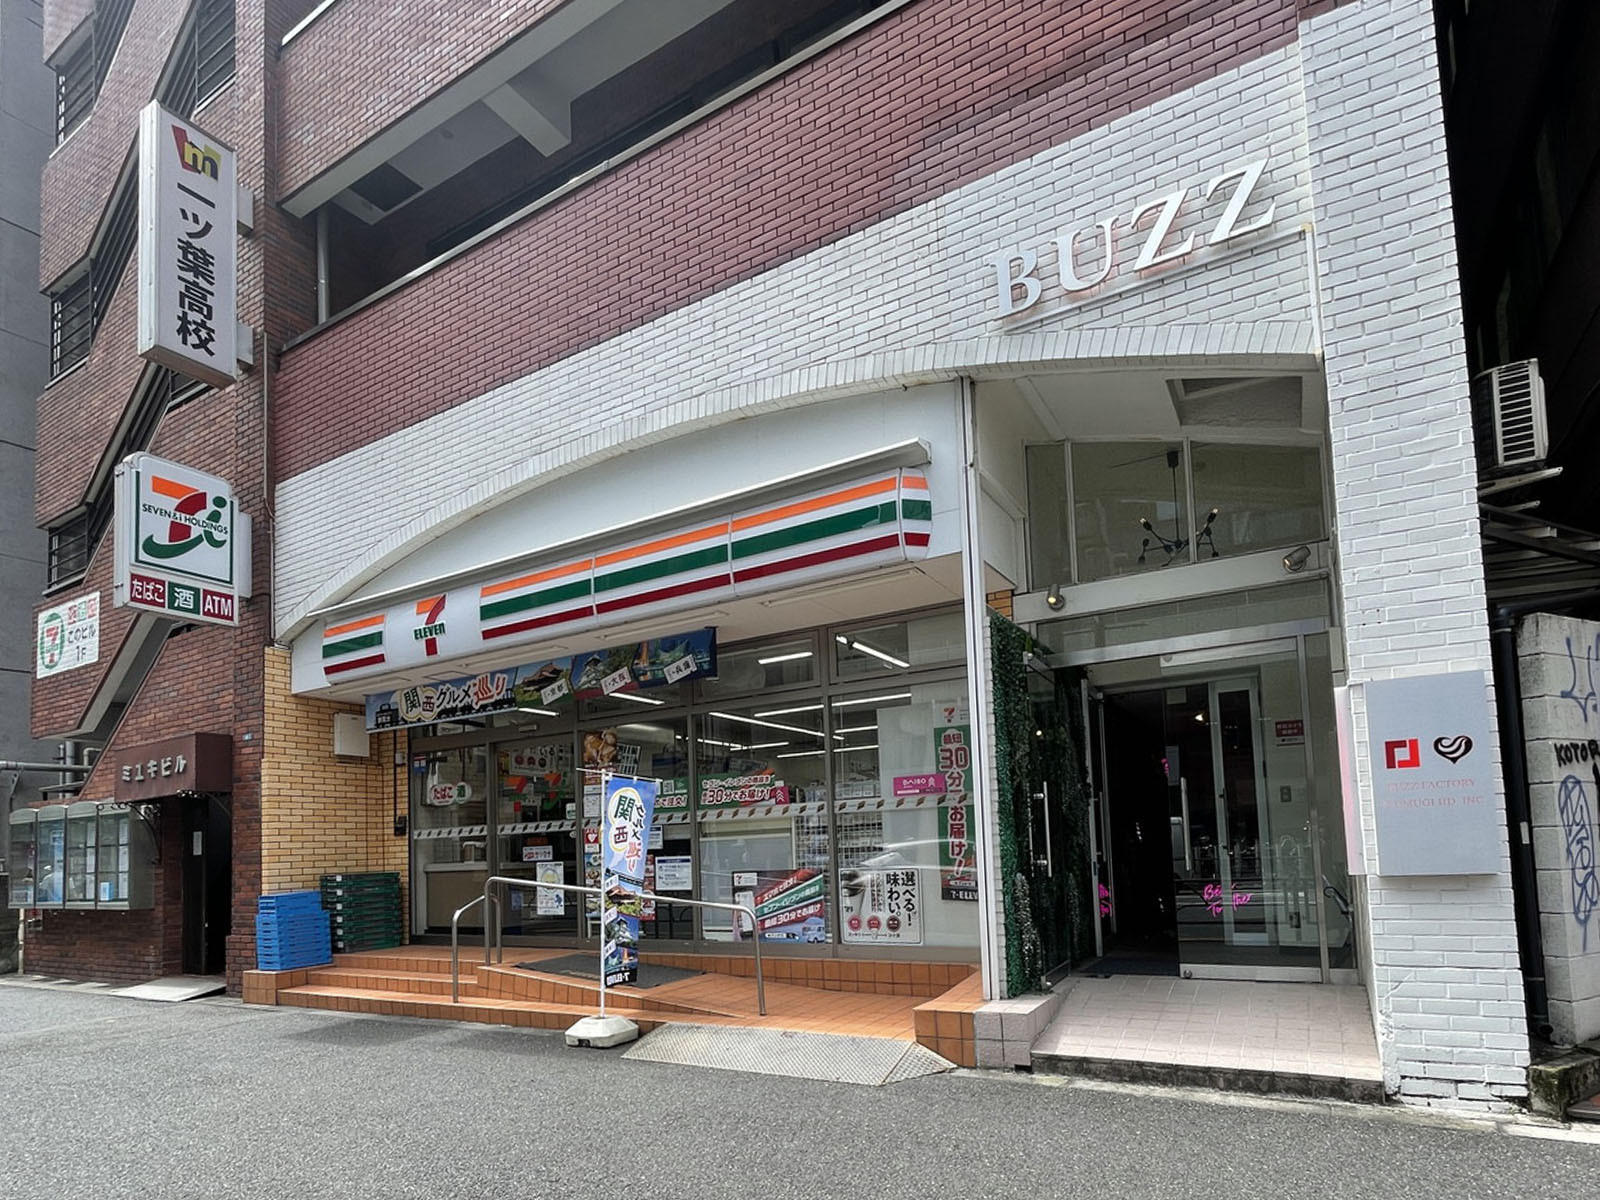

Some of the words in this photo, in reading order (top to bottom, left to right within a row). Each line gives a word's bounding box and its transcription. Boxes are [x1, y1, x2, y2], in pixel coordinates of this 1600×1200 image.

[990, 157, 1277, 322] BUZZ
[176, 182, 217, 357] 一ツ葉高校
[184, 515, 229, 536] HOLDINGS
[131, 578, 165, 603] たばこ
[173, 587, 195, 609] 酒
[204, 594, 233, 617] ATM
[75, 645, 88, 662] 1F
[403, 674, 506, 714] 関西グルメ巡り
[1421, 778, 1475, 790] FACTORY
